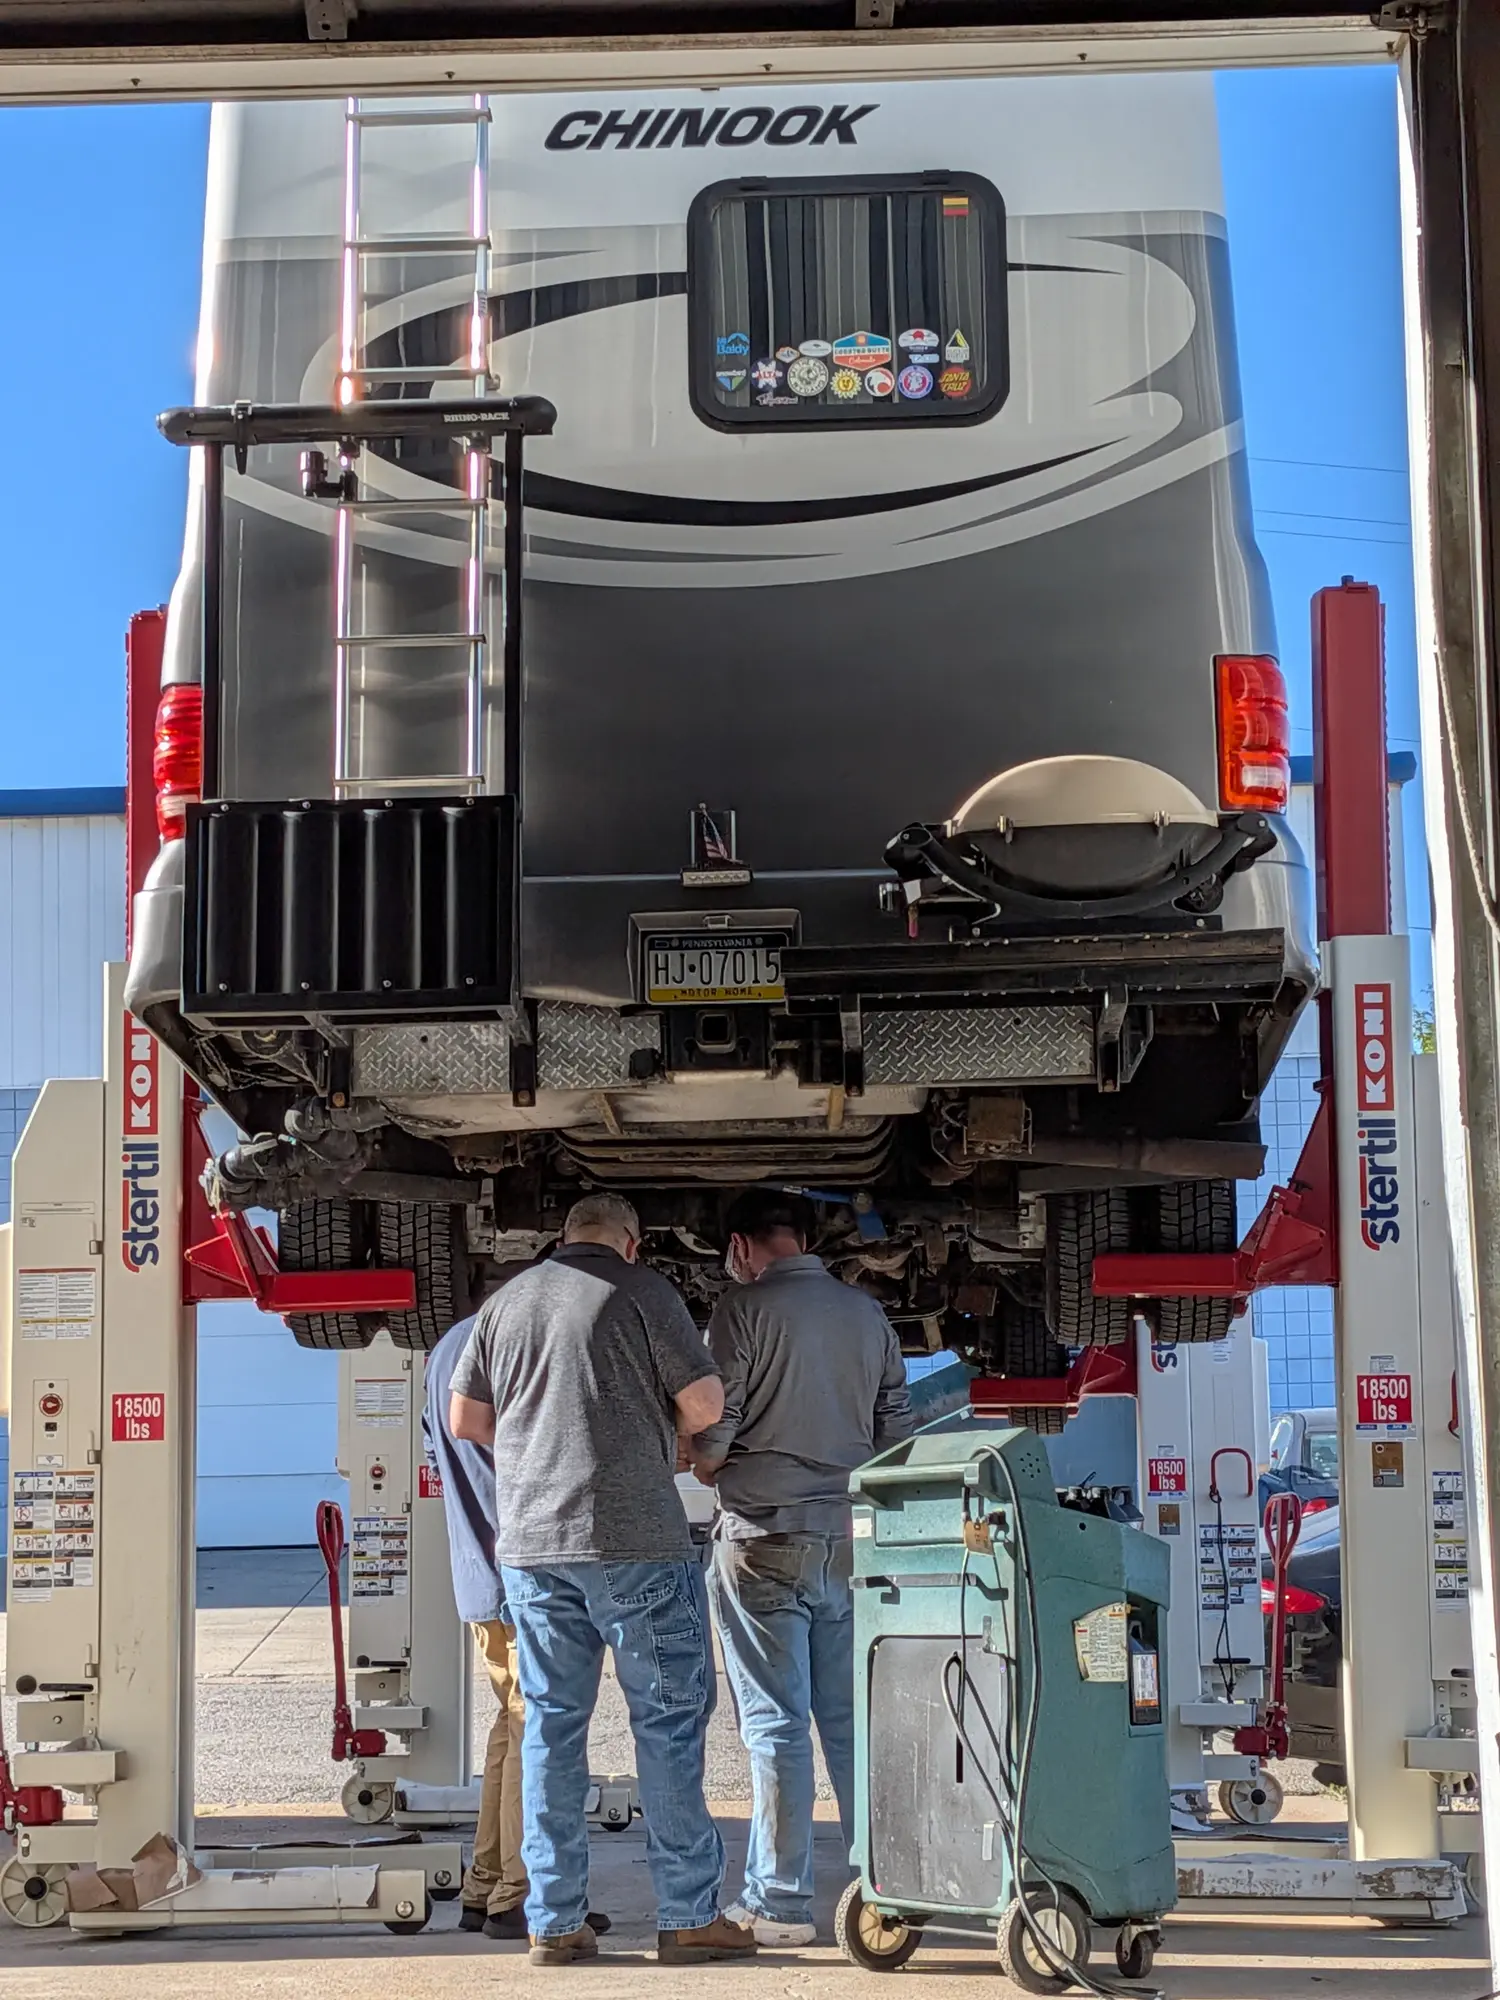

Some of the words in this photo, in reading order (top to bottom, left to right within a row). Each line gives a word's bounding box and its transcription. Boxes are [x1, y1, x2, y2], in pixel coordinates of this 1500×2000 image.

[544, 103, 881, 150] CHINOOK
[756, 371, 777, 379] ALTA
[939, 371, 969, 383] SANTA
[941, 382, 967, 392] CRUZ
[444, 411, 510, 422] RHINO-RACK
[682, 937, 753, 948] PENNSYLVANIA
[680, 988, 717, 997] MOTOR
[724, 987, 753, 996] HOME
[1363, 991, 1386, 1104] KONI
[1358, 1118, 1400, 1251] stertil
[122, 1142, 160, 1273] stertil
[1359, 1378, 1408, 1399] 18500
[115, 1397, 161, 1418] 18500
[1372, 1400, 1398, 1421] lbs
[126, 1418, 150, 1439] lbs
[1150, 1461, 1183, 1476] 18500
[1158, 1476, 1176, 1490] lbs
